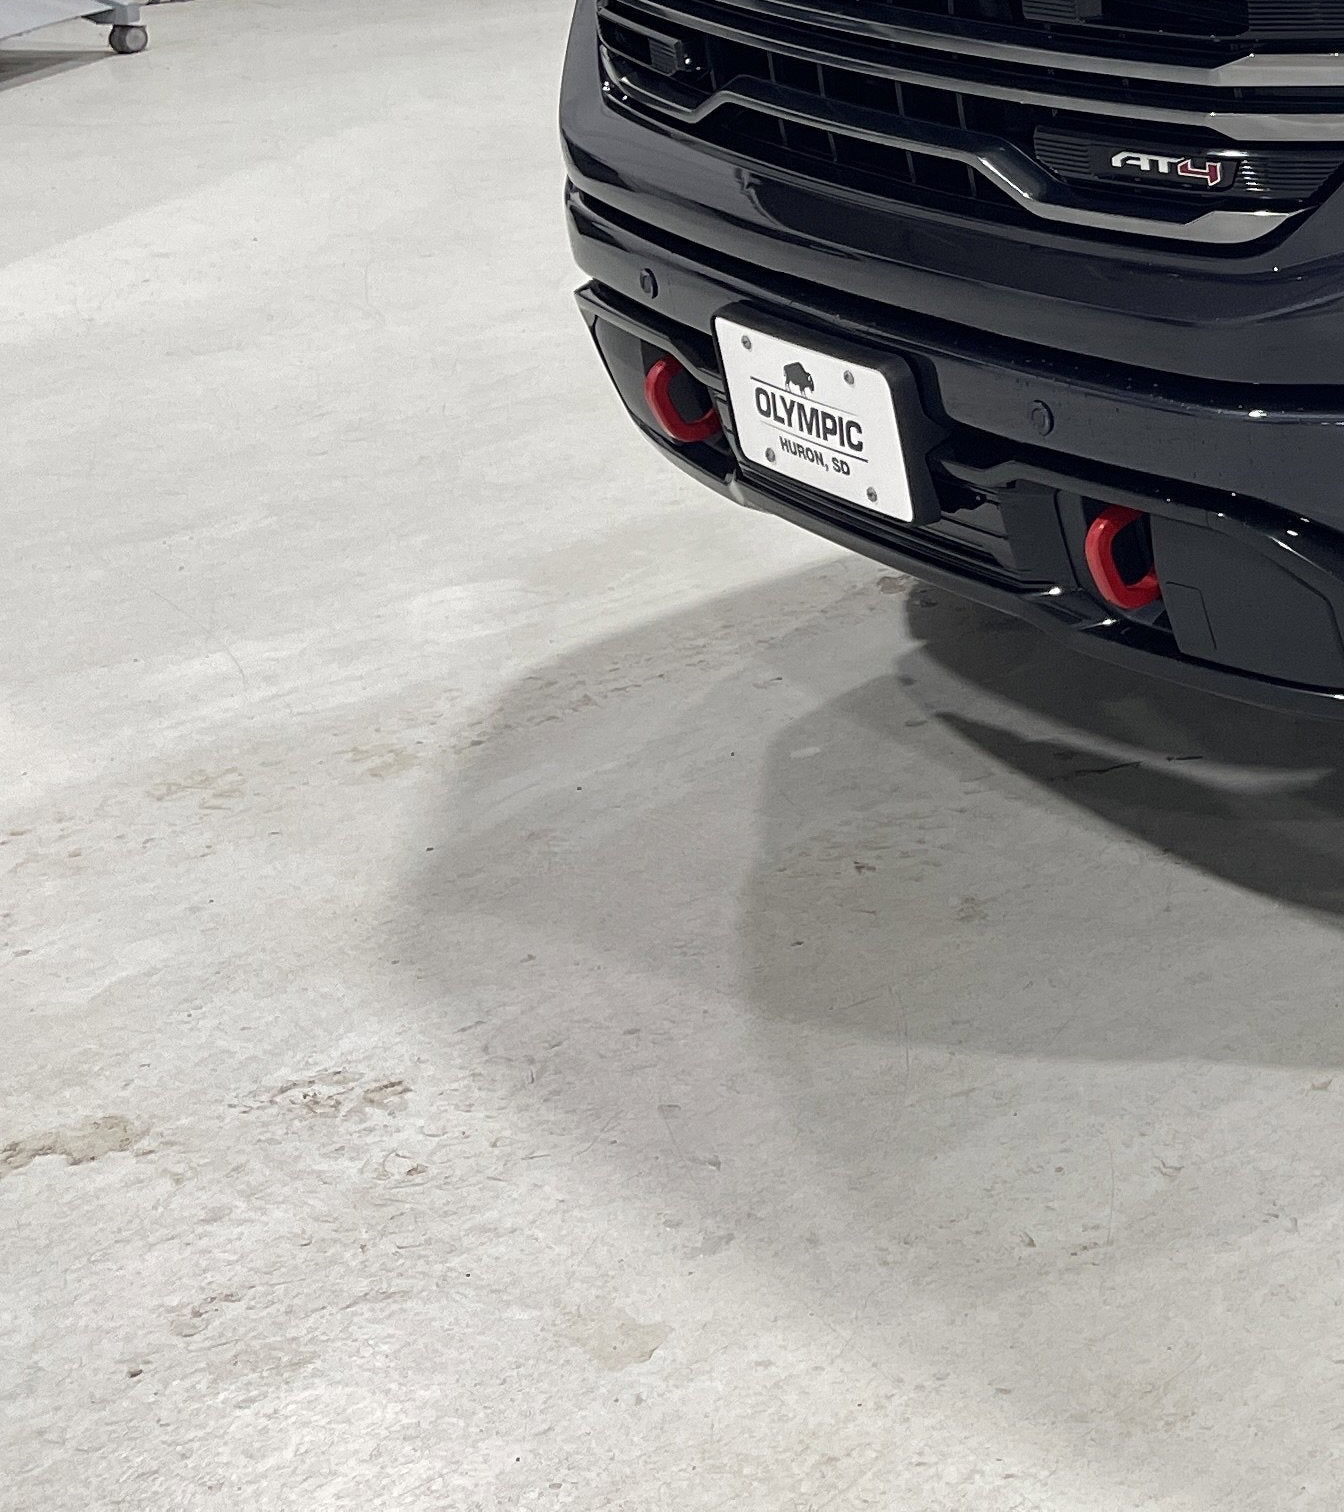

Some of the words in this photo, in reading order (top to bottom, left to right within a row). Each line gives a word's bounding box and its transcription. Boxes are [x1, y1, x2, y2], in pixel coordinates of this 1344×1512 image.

[1111, 151, 1222, 187] AT4
[754, 387, 864, 452] OLYMPIC
[779, 435, 829, 472] HURON,
[832, 457, 851, 476] SD
